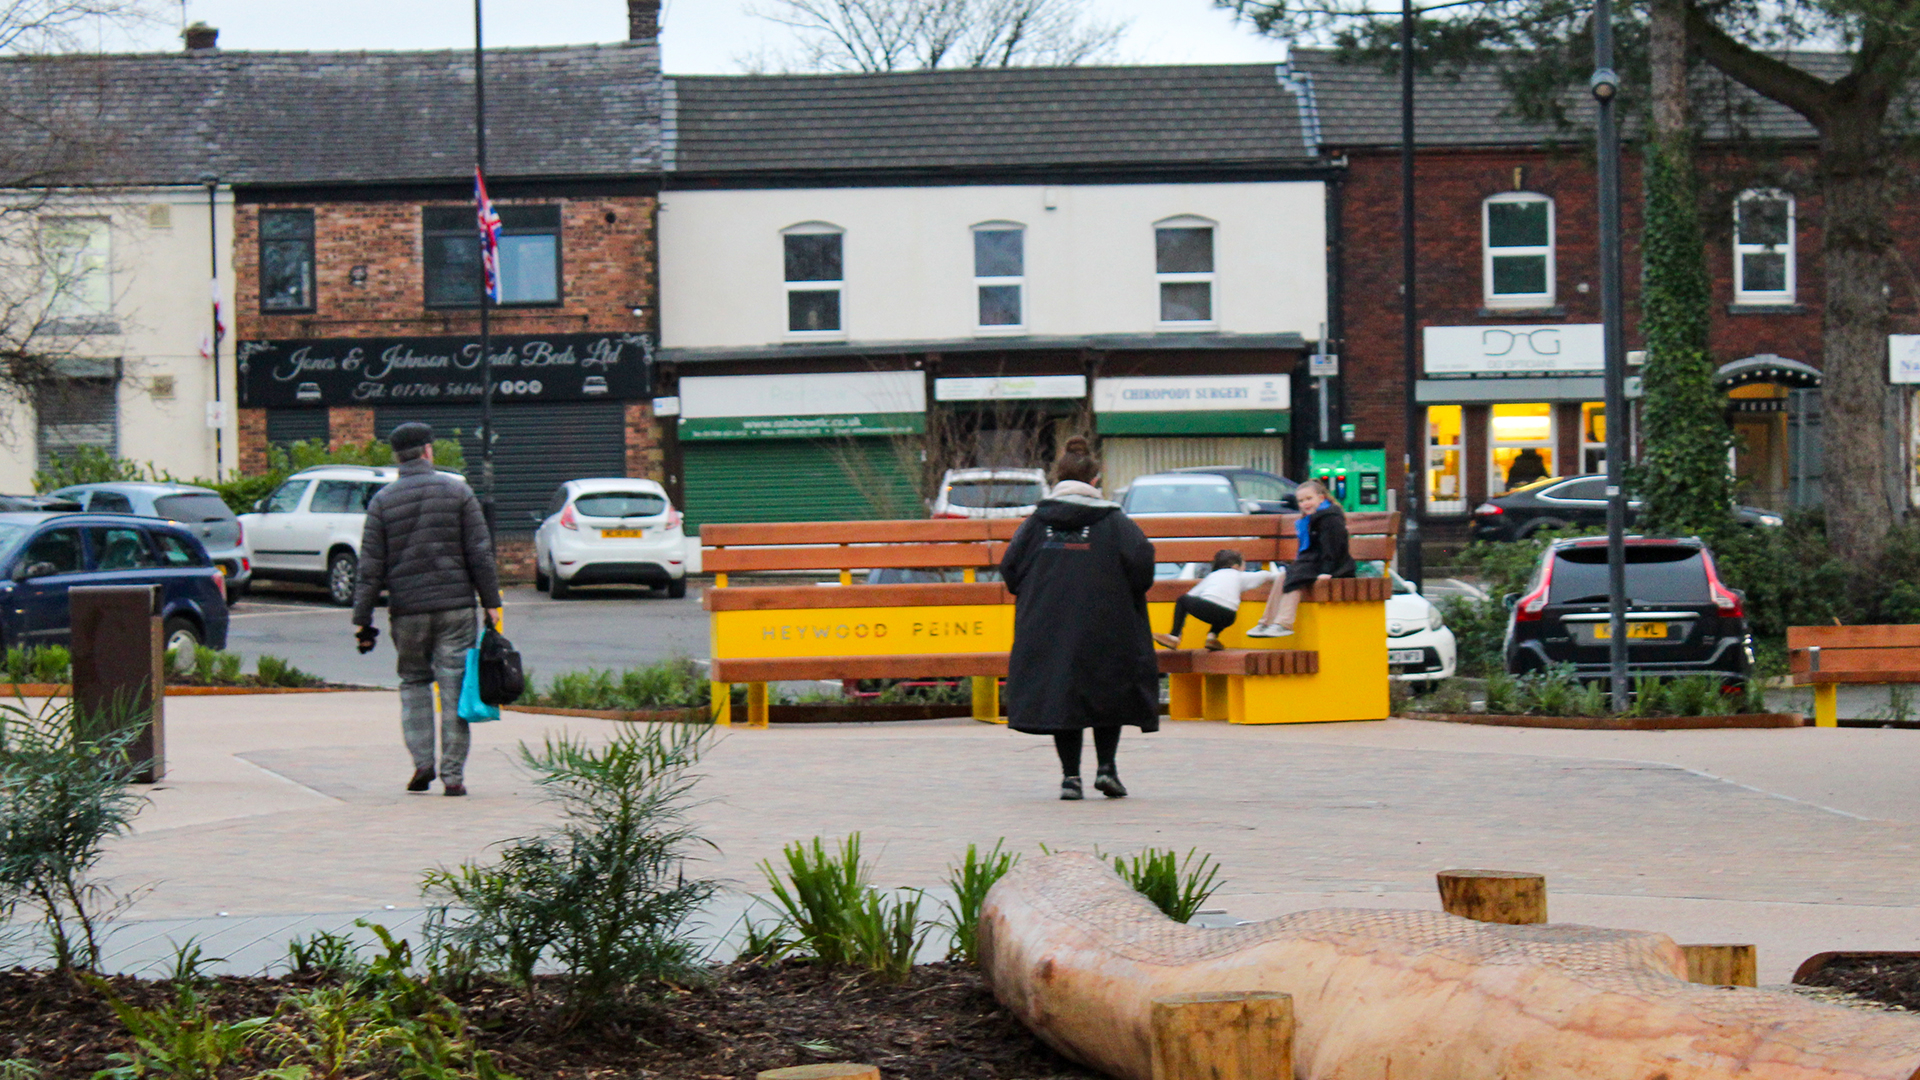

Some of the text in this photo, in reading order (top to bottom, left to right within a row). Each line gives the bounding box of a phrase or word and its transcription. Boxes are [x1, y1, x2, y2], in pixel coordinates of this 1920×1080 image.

[272, 346, 336, 381] Jones
[341, 347, 364, 371] &
[364, 344, 449, 379] Johnson
[521, 341, 576, 367] Beds
[581, 338, 623, 372] Ltd
[392, 383, 440, 397] 01706
[1122, 388, 1191, 400] CHIROPODY
[1195, 387, 1250, 399] SURGERY
[762, 621, 983, 640] HEYWOOD PEINE
